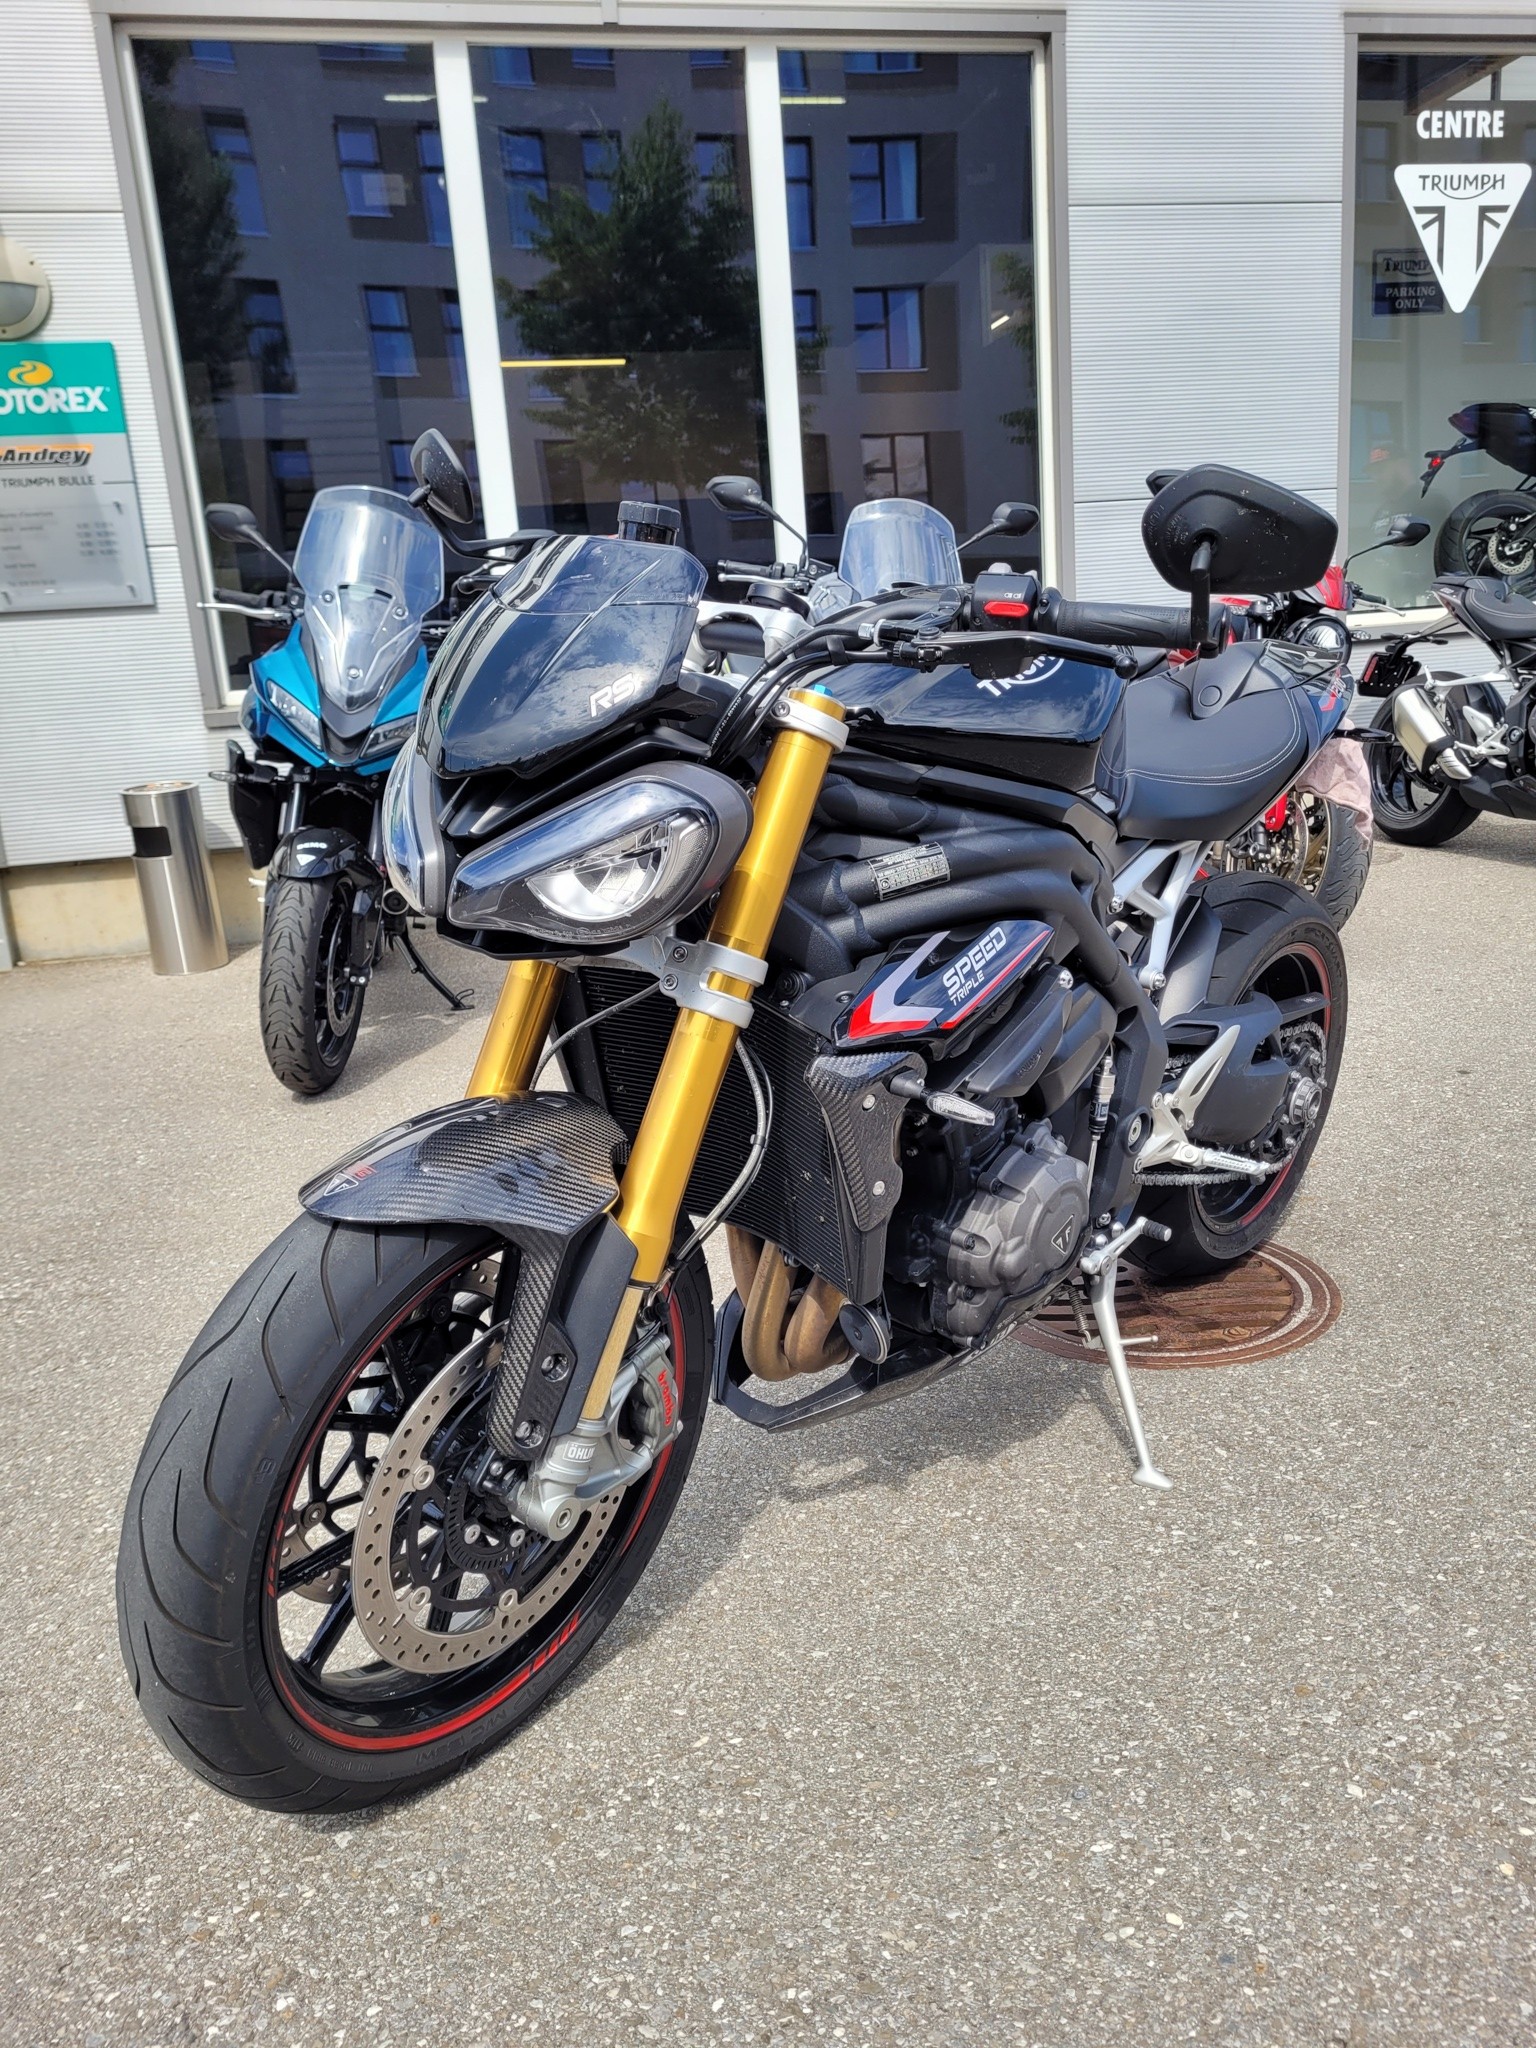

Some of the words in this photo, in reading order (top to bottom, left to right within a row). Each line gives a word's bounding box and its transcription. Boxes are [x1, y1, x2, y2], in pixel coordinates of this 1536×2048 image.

[1416, 110, 1504, 139] CENTRE
[1418, 174, 1505, 199] TRIUMPH
[1383, 256, 1432, 275] TRIUMP
[1385, 286, 1436, 297] PARKING
[1395, 298, 1425, 309] ONLY
[0, 385, 109, 415] OTOREX
[3, 448, 86, 465] Andrey
[1, 477, 55, 488] TRIUMPH
[58, 474, 95, 486] BULLE
[589, 672, 636, 718] RS
[296, 841, 328, 850] DEMO
[942, 926, 1007, 996] SPEED
[950, 970, 985, 1006] TRIPLE
[657, 1369, 675, 1426] brembo
